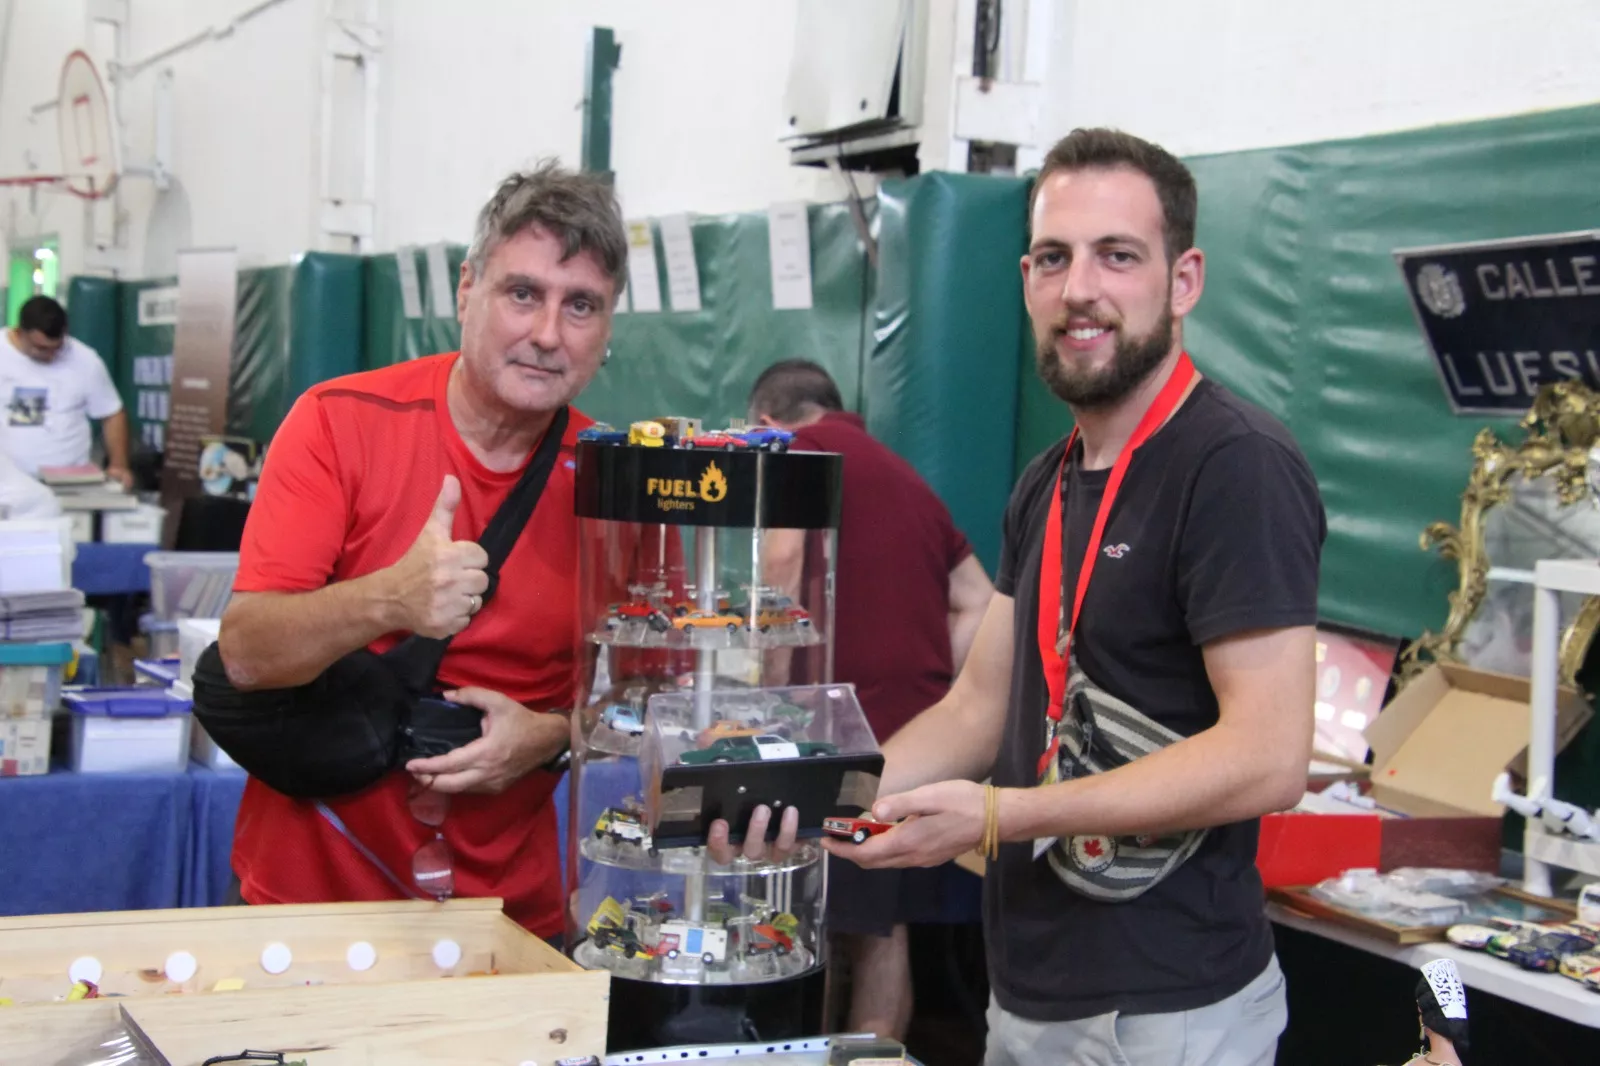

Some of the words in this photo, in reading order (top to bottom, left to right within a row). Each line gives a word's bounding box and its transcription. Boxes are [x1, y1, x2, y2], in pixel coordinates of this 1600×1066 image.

[1476, 256, 1600, 299] CALLE
[647, 478, 697, 497] FUEL
[658, 498, 694, 511] lighters
